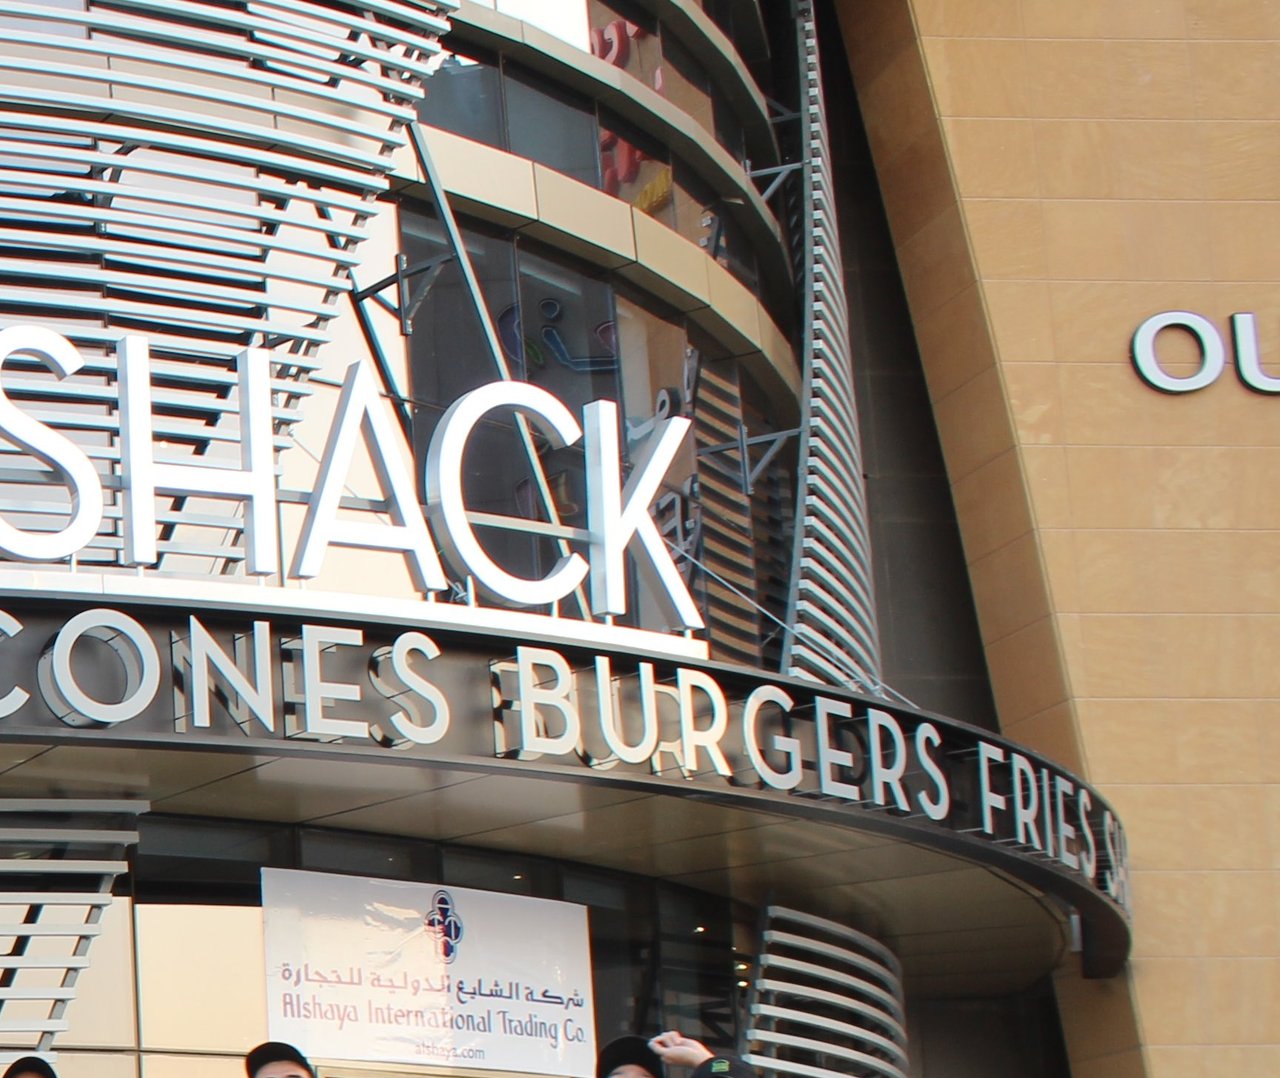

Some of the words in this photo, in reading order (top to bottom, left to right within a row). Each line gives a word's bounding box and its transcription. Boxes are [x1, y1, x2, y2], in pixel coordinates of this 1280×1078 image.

[515, 645, 950, 822] BURGERS
[978, 741, 1097, 880] FRIES
[282, 992, 359, 1031] Alshaya
[367, 999, 492, 1034] International
[496, 1010, 559, 1049] Trading
[524, 988, 585, 1010] شركة
